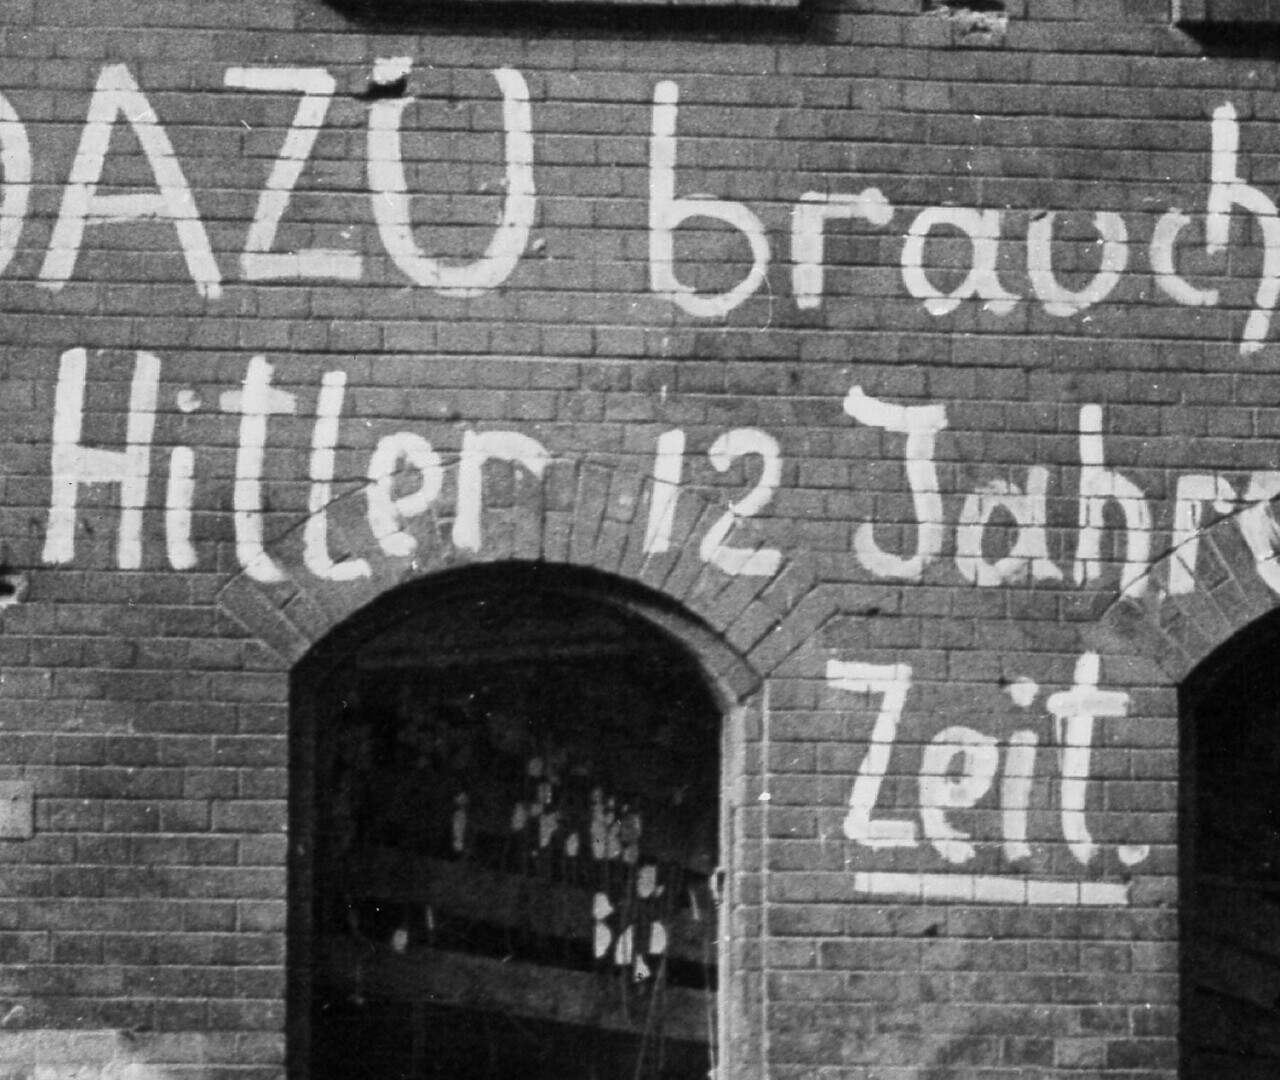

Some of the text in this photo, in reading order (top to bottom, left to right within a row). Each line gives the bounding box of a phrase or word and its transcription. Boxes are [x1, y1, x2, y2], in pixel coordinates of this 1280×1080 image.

[42, 347, 553, 582] Hitler
[642, 427, 783, 577] 12
[824, 651, 1150, 865] Zeit.
